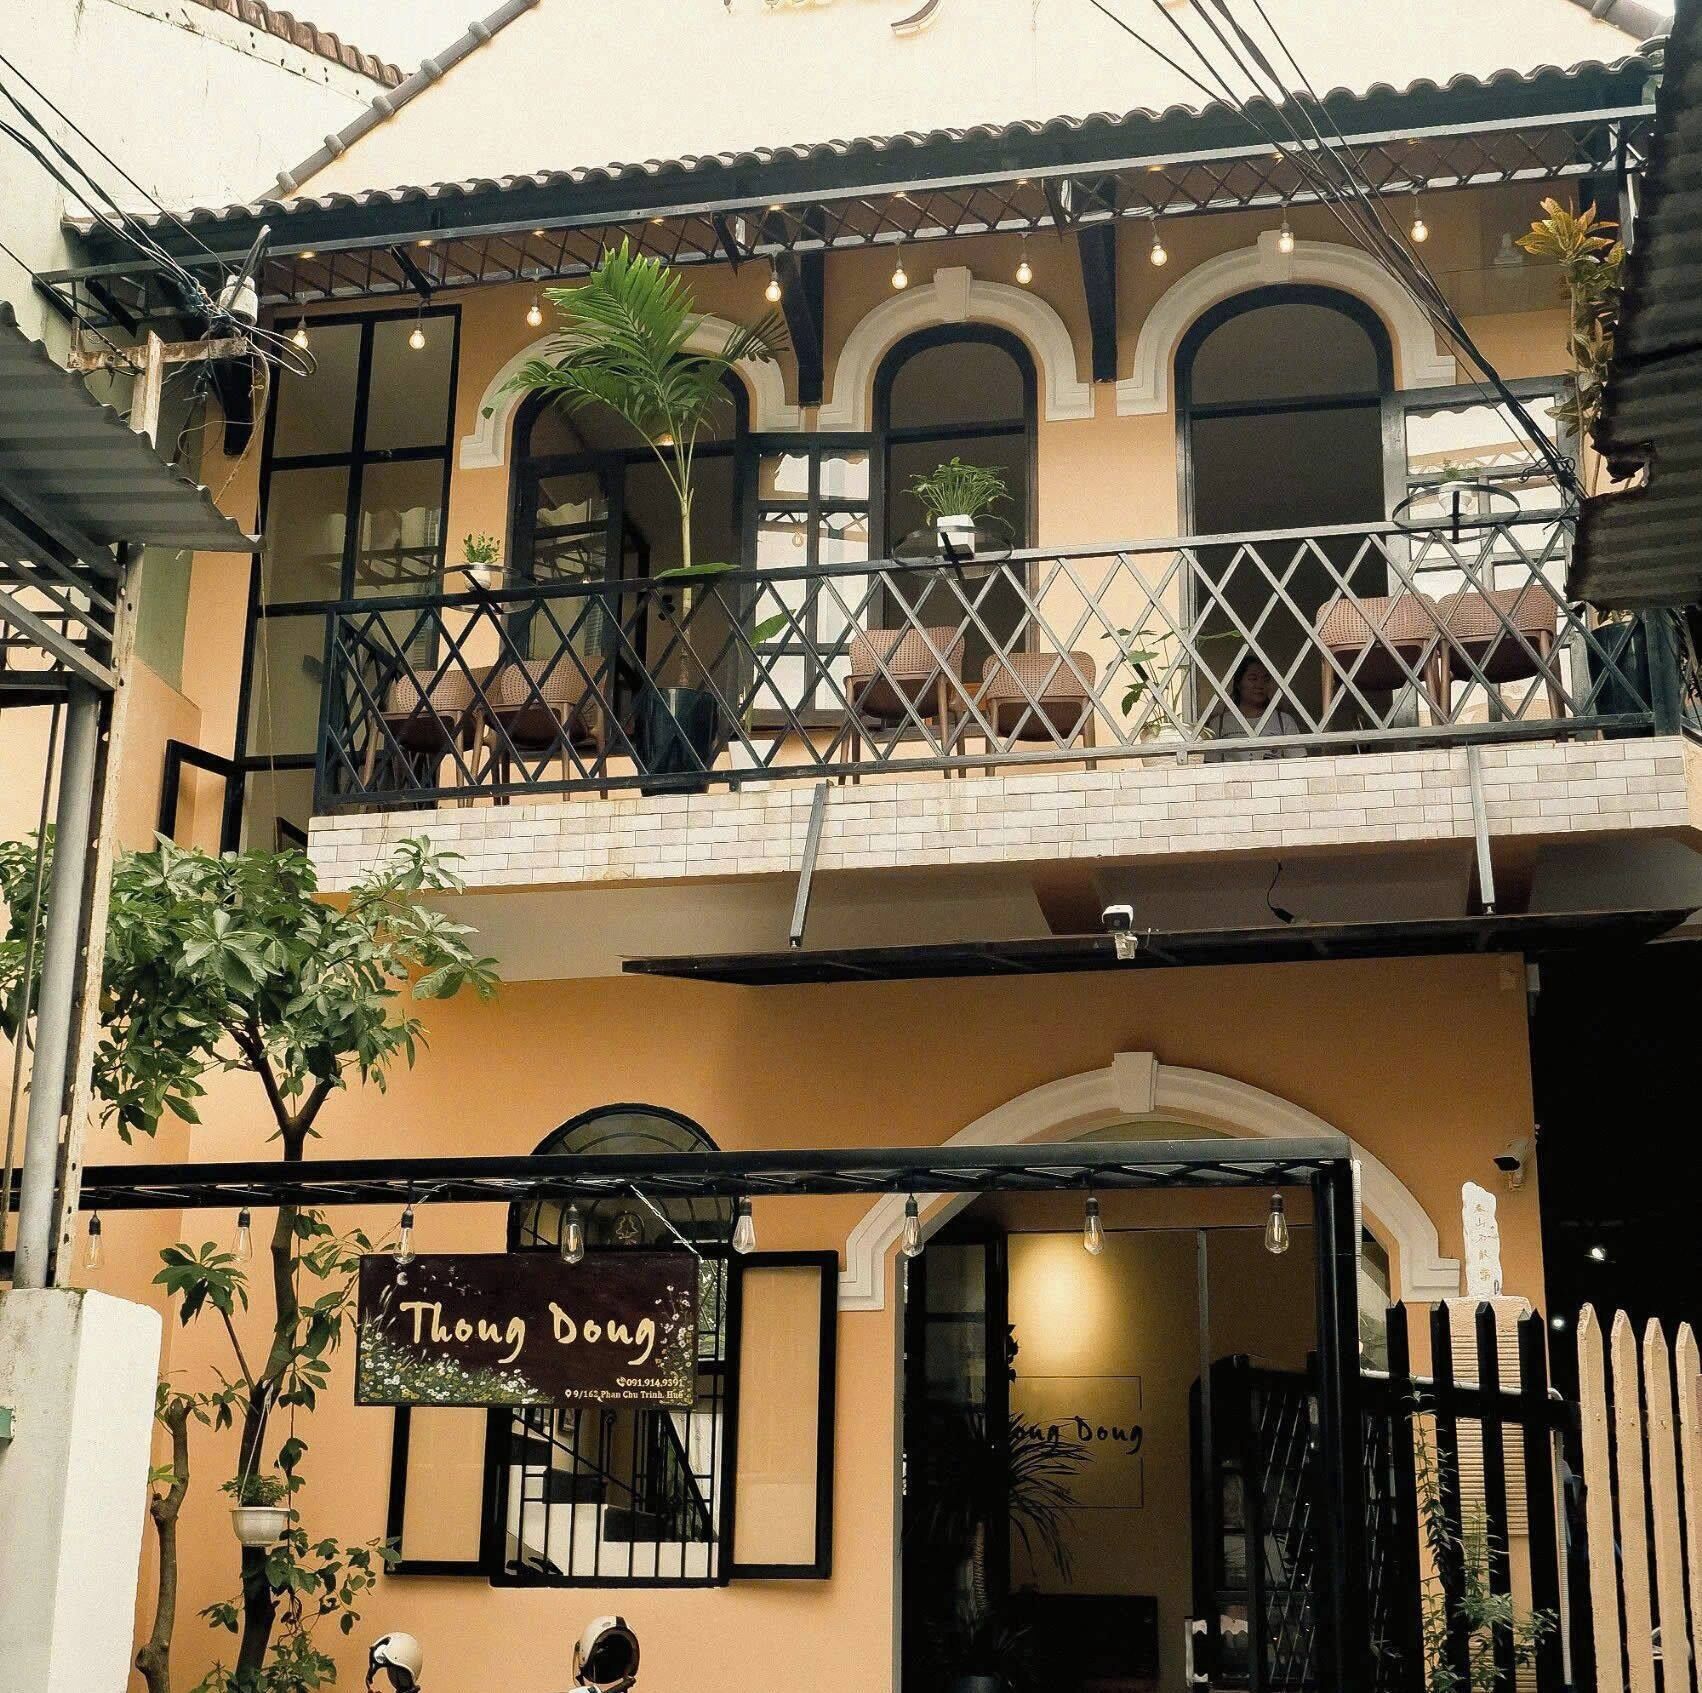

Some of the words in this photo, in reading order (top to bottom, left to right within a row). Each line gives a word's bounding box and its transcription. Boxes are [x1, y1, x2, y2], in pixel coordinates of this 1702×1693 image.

[400, 1302, 526, 1364] Thong
[548, 1302, 655, 1366] Dong
[573, 1389, 599, 1400] 9/162
[600, 1390, 621, 1399] Phan
[622, 1390, 639, 1399] Chu
[1074, 1415, 1143, 1455] Dong
